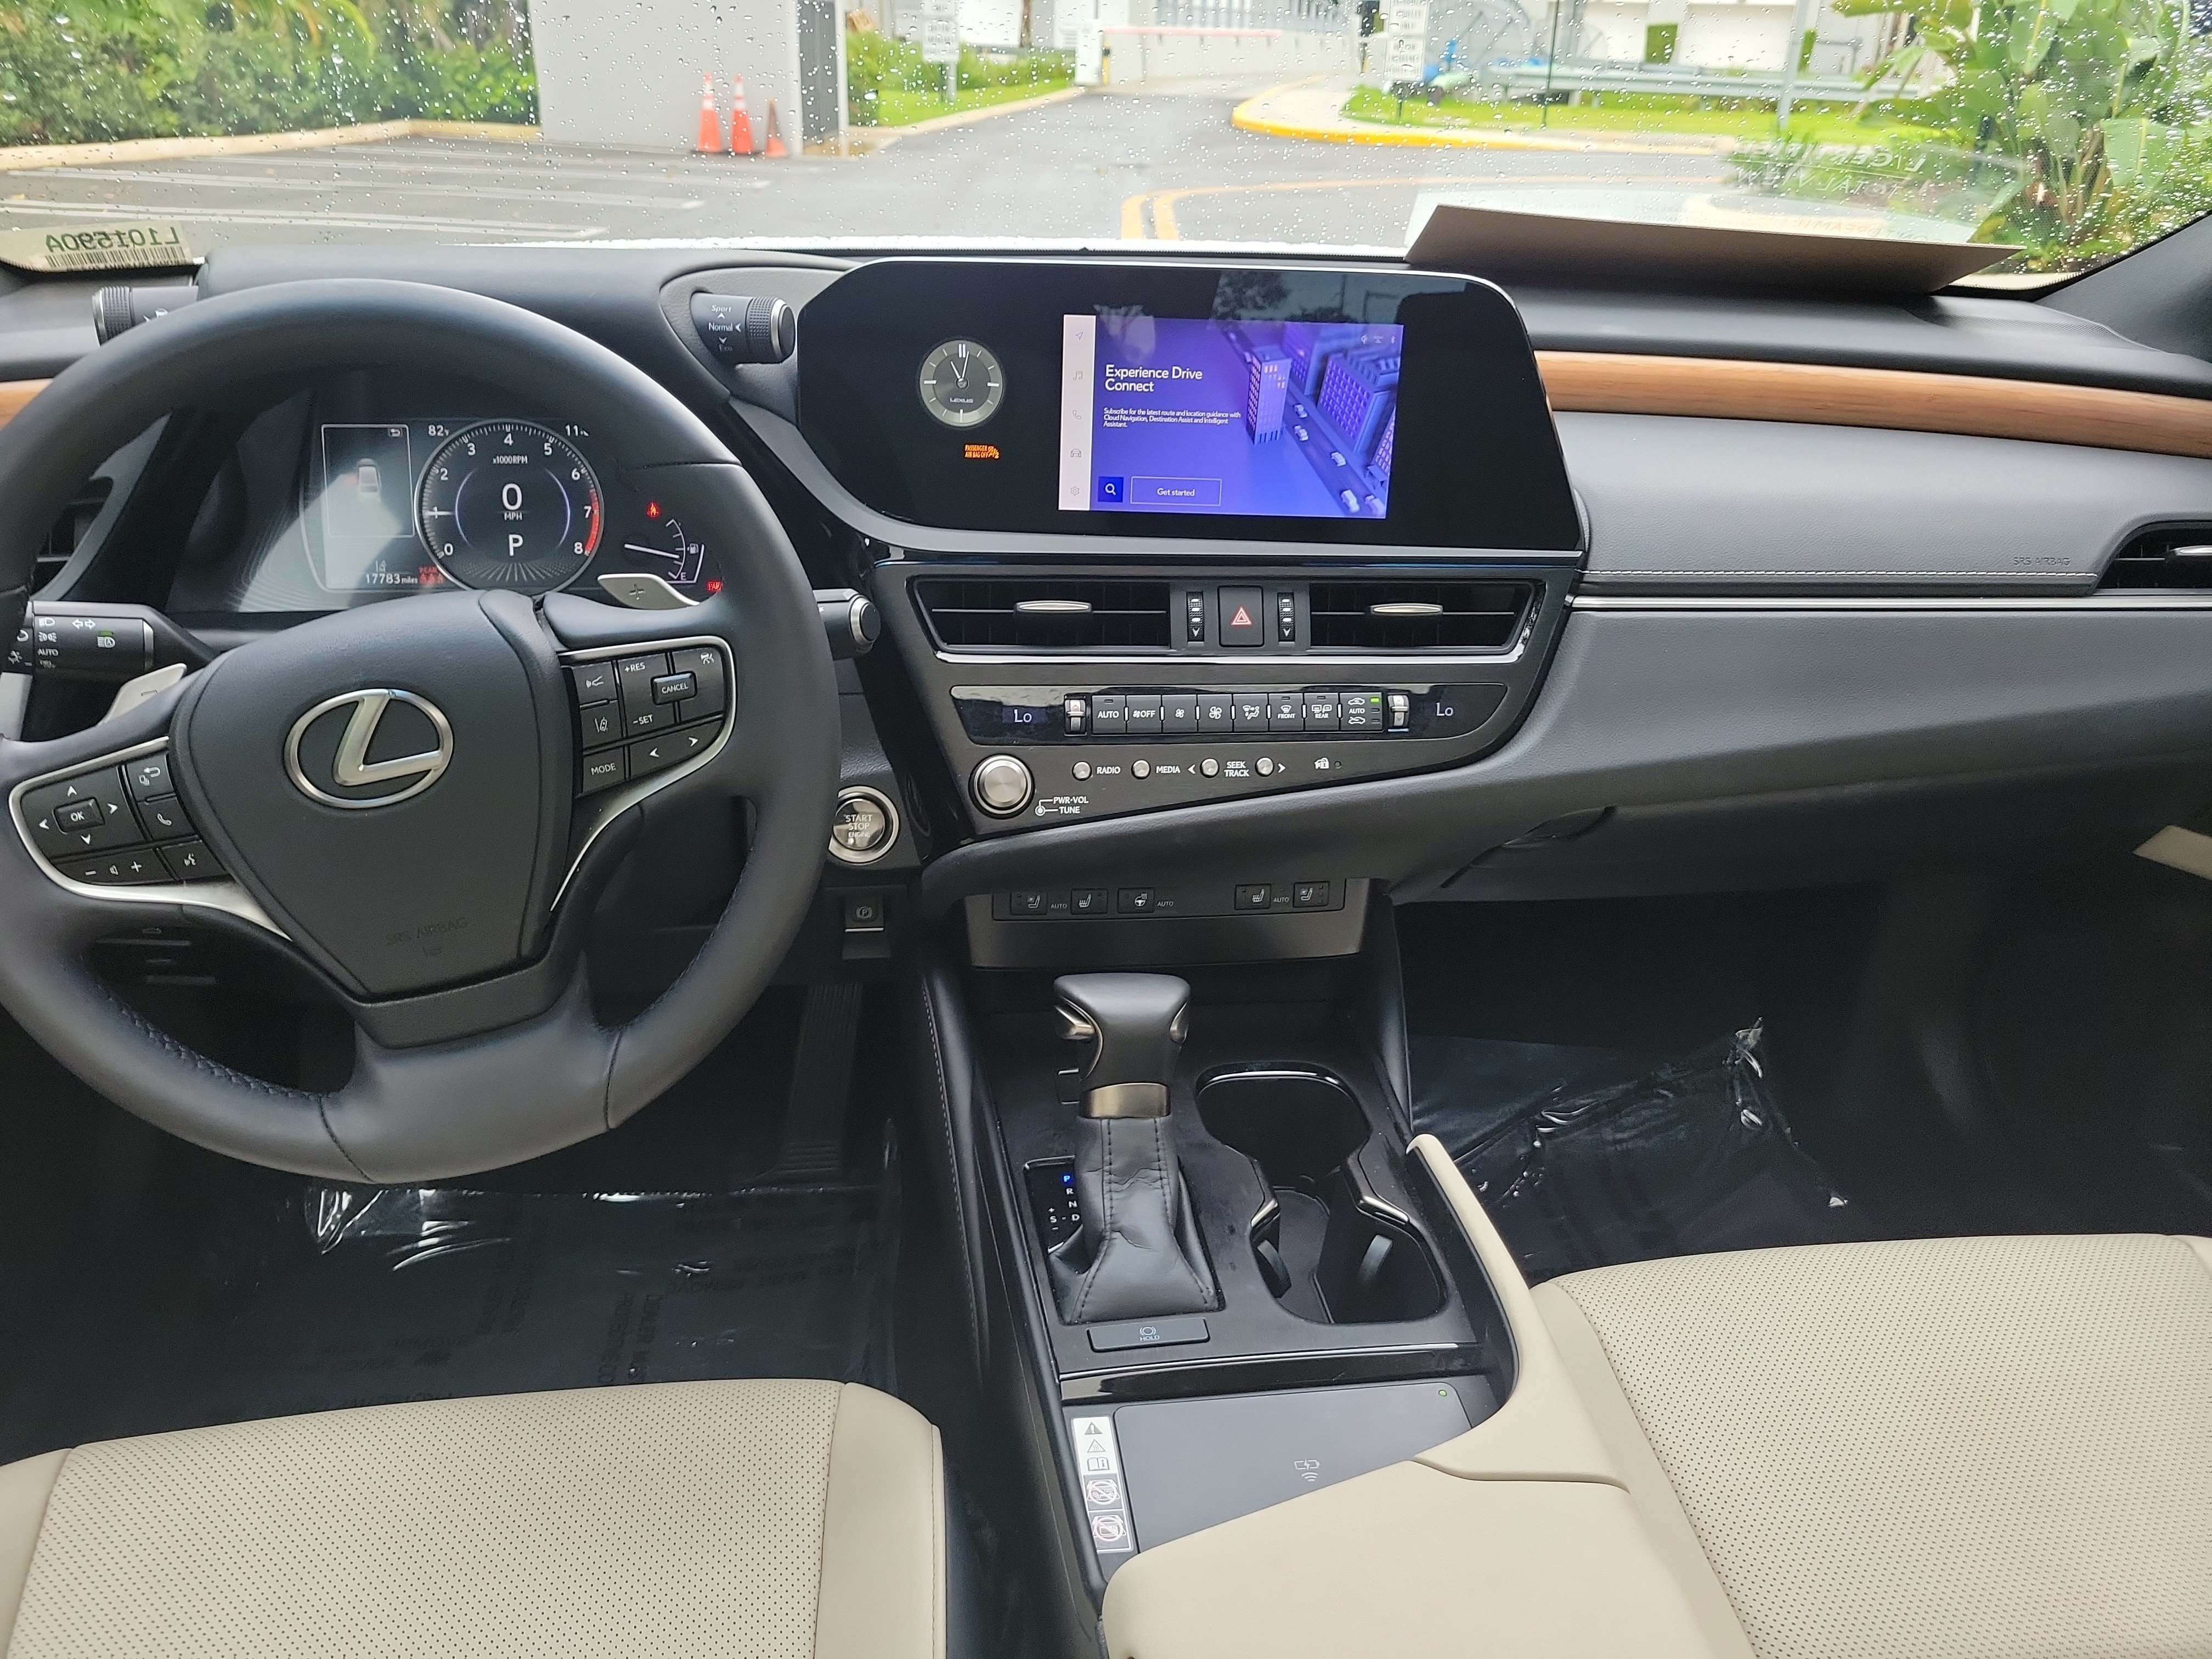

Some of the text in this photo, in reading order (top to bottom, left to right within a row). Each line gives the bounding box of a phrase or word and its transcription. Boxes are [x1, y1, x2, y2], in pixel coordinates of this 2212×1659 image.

[711, 304, 732, 313] Sport
[708, 321, 733, 332] Normal
[1105, 364, 1203, 380] Experience Drive
[1105, 378, 1155, 392] Connect
[1120, 414, 1148, 422] Navigation,
[504, 433, 514, 445] 4
[467, 442, 476, 456] 3
[544, 442, 552, 456] 5
[440, 467, 448, 481] 2
[571, 468, 580, 481] 6
[502, 483, 522, 511] 0
[1157, 488, 1171, 496] Get
[504, 512, 522, 521] MPH
[584, 506, 591, 518] 7
[444, 543, 454, 556] 0
[508, 534, 523, 556] P
[573, 541, 583, 555] 8
[366, 573, 418, 584] 17783 miles
[680, 572, 687, 580] E
[37, 648, 59, 657] AUTO
[661, 682, 689, 695] CANCEL
[1097, 710, 1119, 719] AUTO
[1140, 709, 1156, 719] OFF
[1436, 702, 1453, 717] Lo
[1014, 709, 1032, 723] Lo
[590, 762, 617, 776] MODE
[1156, 765, 1181, 774] MEDIA
[1226, 760, 1246, 769] SEEK
[1097, 766, 1121, 775] RADIO
[1223, 769, 1249, 777] TRACK
[1059, 806, 1080, 814] TUNE
[70, 811, 86, 822] OK
[845, 814, 873, 822] START
[848, 822, 870, 831] STOP
